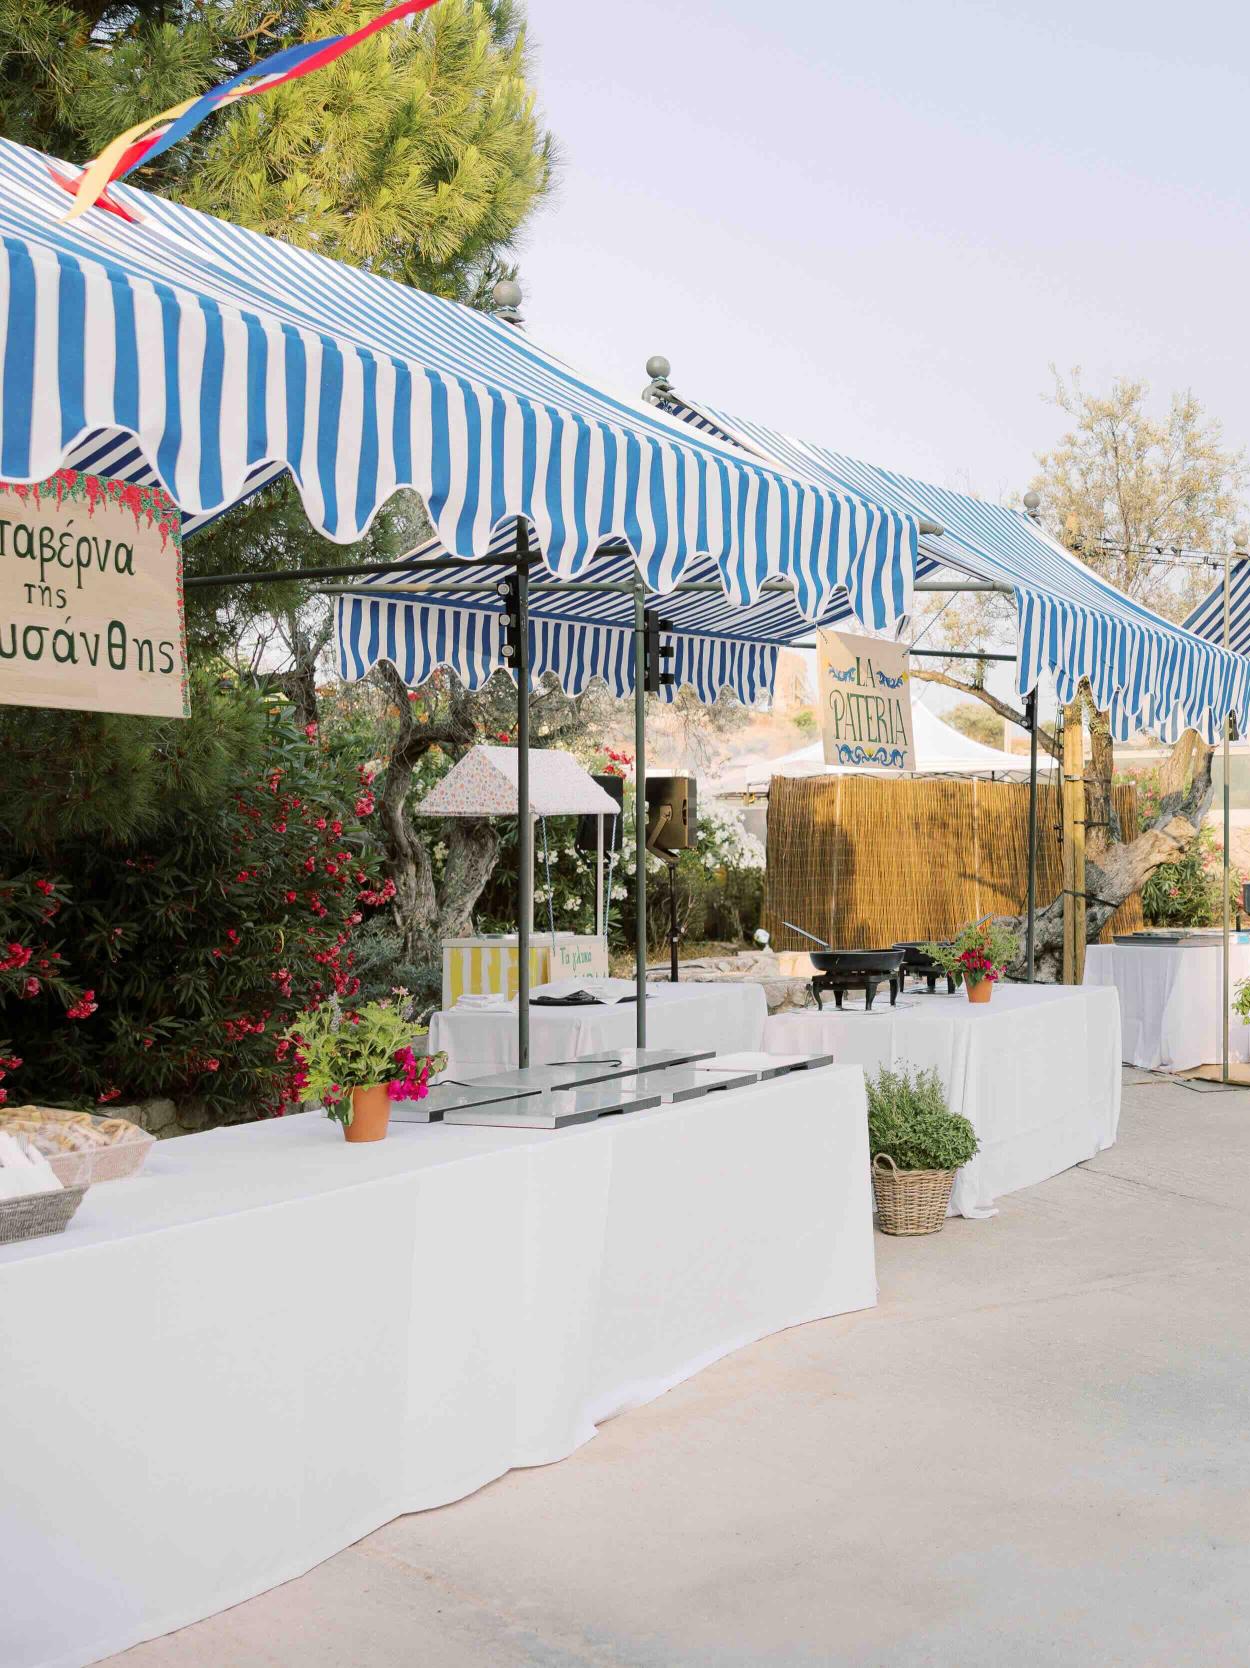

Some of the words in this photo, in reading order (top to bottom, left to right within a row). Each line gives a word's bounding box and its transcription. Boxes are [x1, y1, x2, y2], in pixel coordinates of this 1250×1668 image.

[24, 583, 67, 609] της
[855, 656, 876, 688] LA
[829, 689, 908, 746] PATERIA
